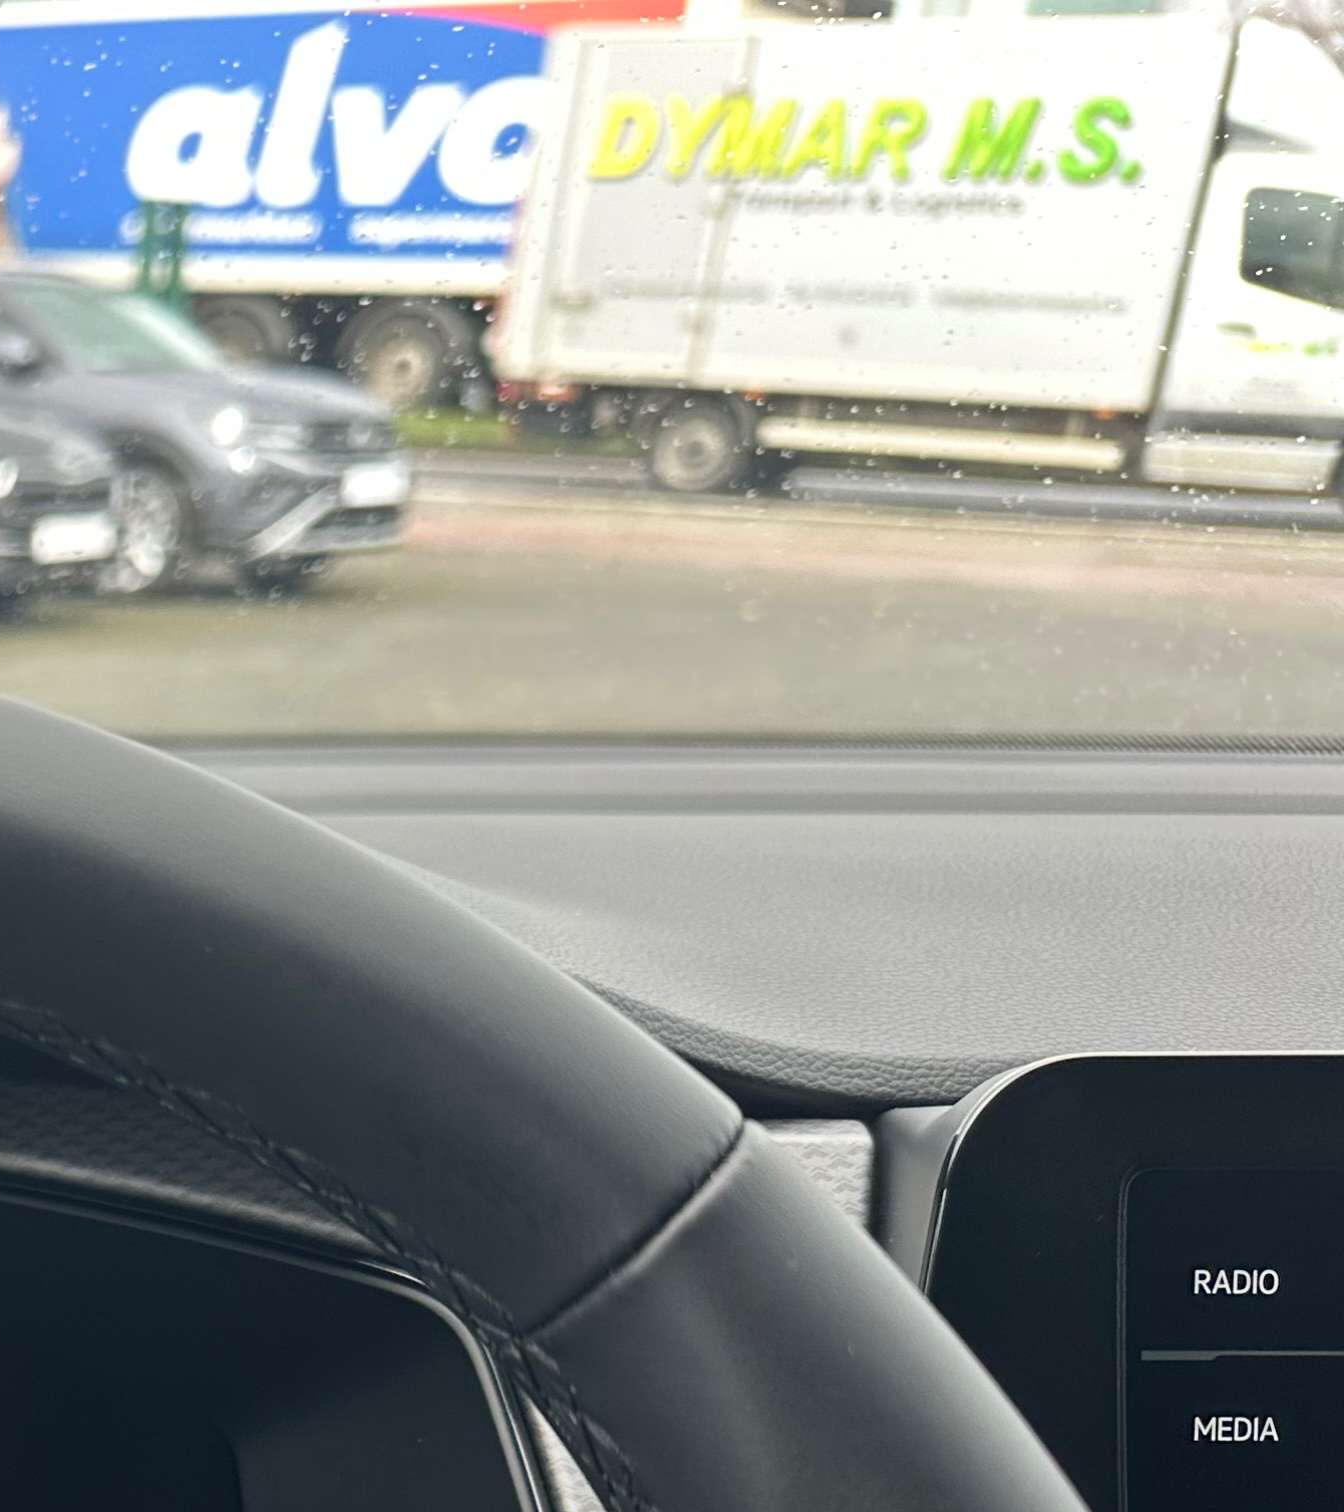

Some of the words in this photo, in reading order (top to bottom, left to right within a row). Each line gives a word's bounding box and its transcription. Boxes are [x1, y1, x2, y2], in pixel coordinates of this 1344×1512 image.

[587, 93, 928, 182] DYMAR
[942, 96, 1144, 186] M.S.
[1193, 1269, 1279, 1296] RADIO
[1193, 1416, 1279, 1443] MEDIA
